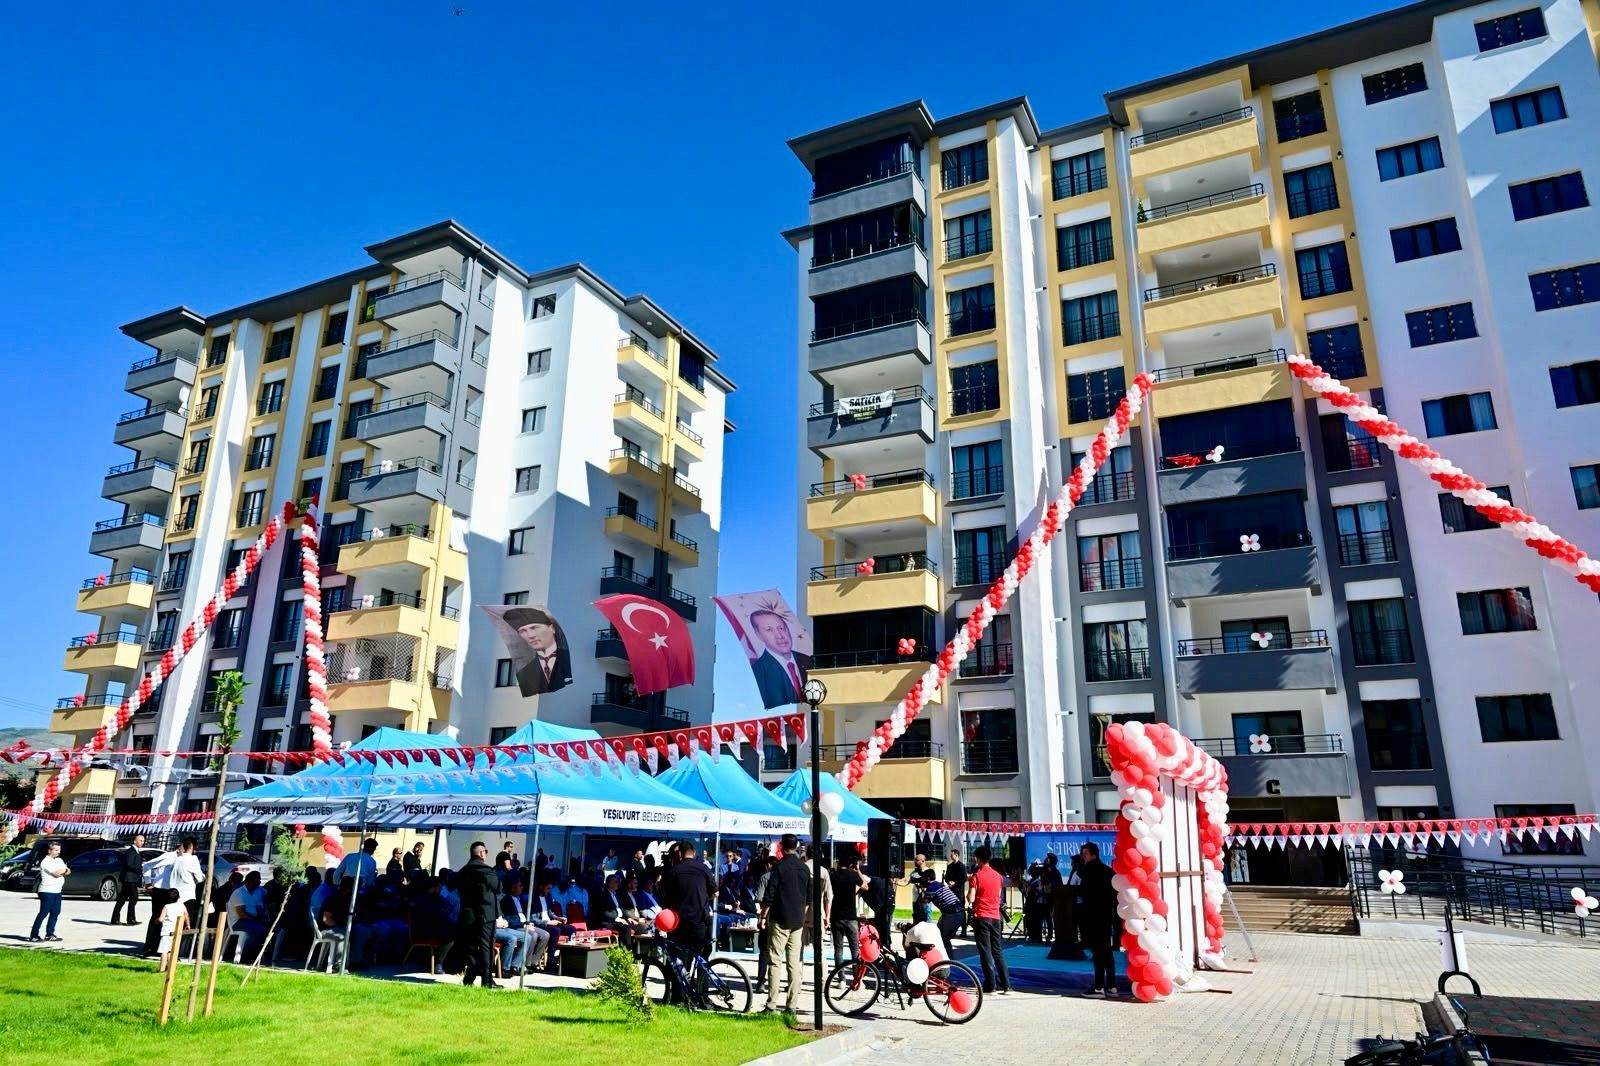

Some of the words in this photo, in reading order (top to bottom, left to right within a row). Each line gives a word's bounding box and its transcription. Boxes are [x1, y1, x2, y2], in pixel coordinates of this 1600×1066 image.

[1266, 779, 1281, 795] C
[252, 806, 290, 816] YEŞİLYURT
[403, 805, 448, 816] YEŞİLYURT
[450, 805, 498, 816] BELEDİYESİ
[603, 808, 641, 821] YEŞİLYURT
[642, 811, 676, 823] BELEDİYESİ
